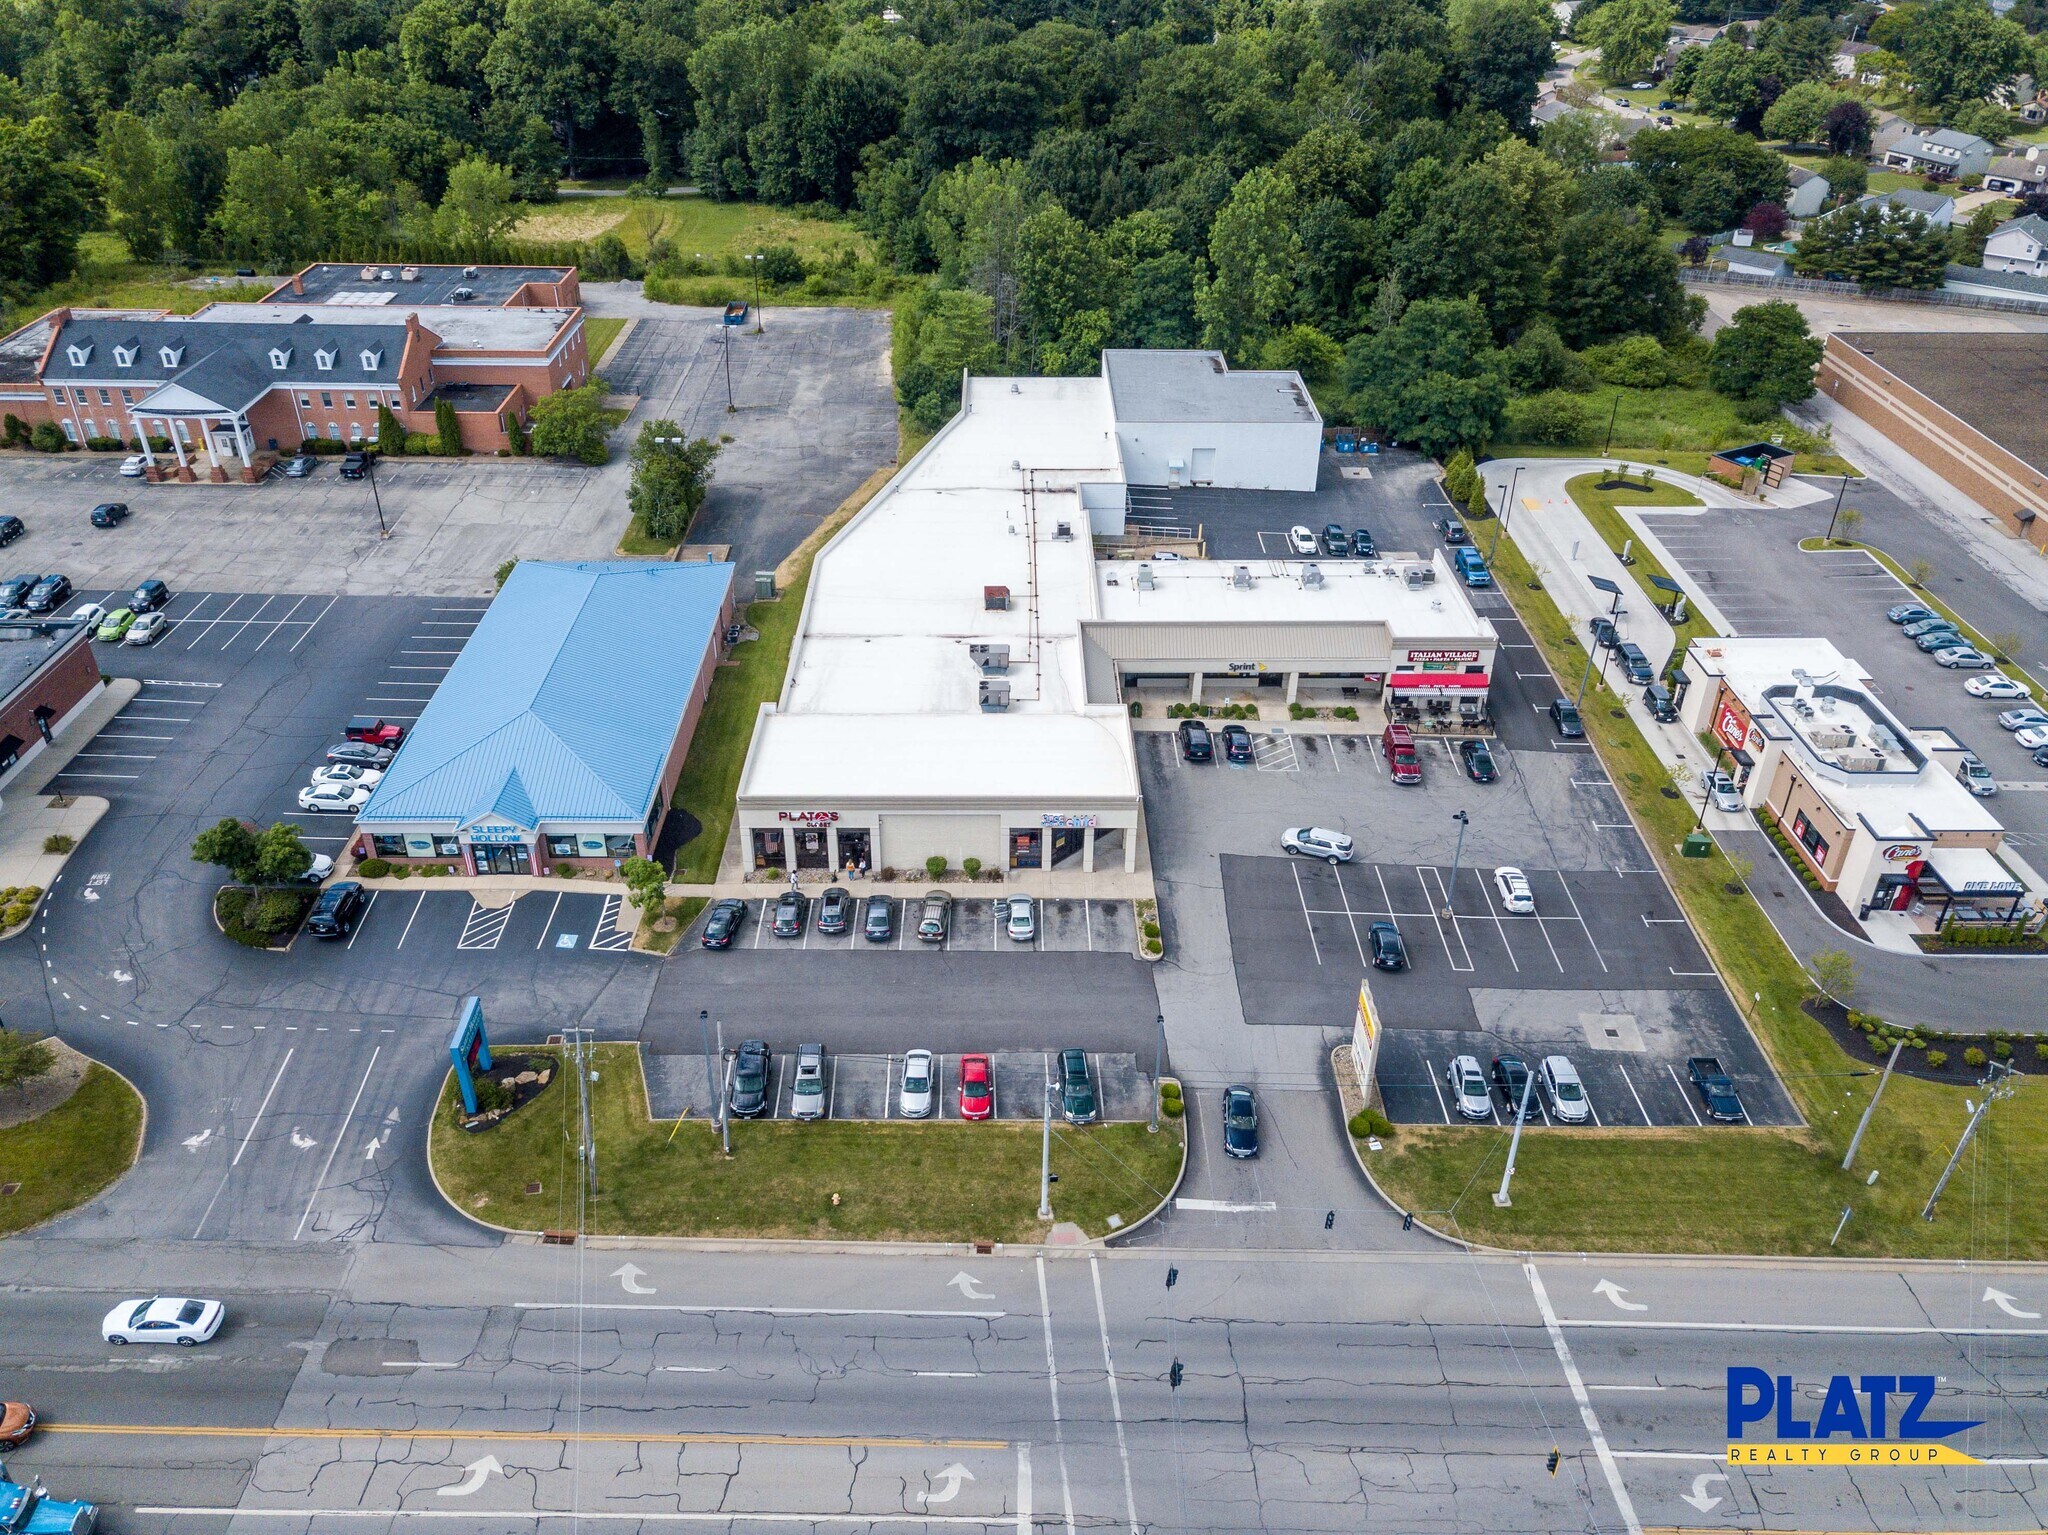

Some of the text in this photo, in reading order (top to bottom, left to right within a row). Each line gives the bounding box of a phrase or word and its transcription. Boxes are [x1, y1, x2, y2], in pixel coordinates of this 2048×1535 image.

[1228, 662, 1255, 672] Sprint
[778, 811, 839, 822] PLATO'S
[1066, 814, 1097, 828] child
[471, 825, 517, 834] SLEEPY
[470, 834, 520, 843] HOLLOW
[1964, 881, 2022, 891] ONE LOVE
